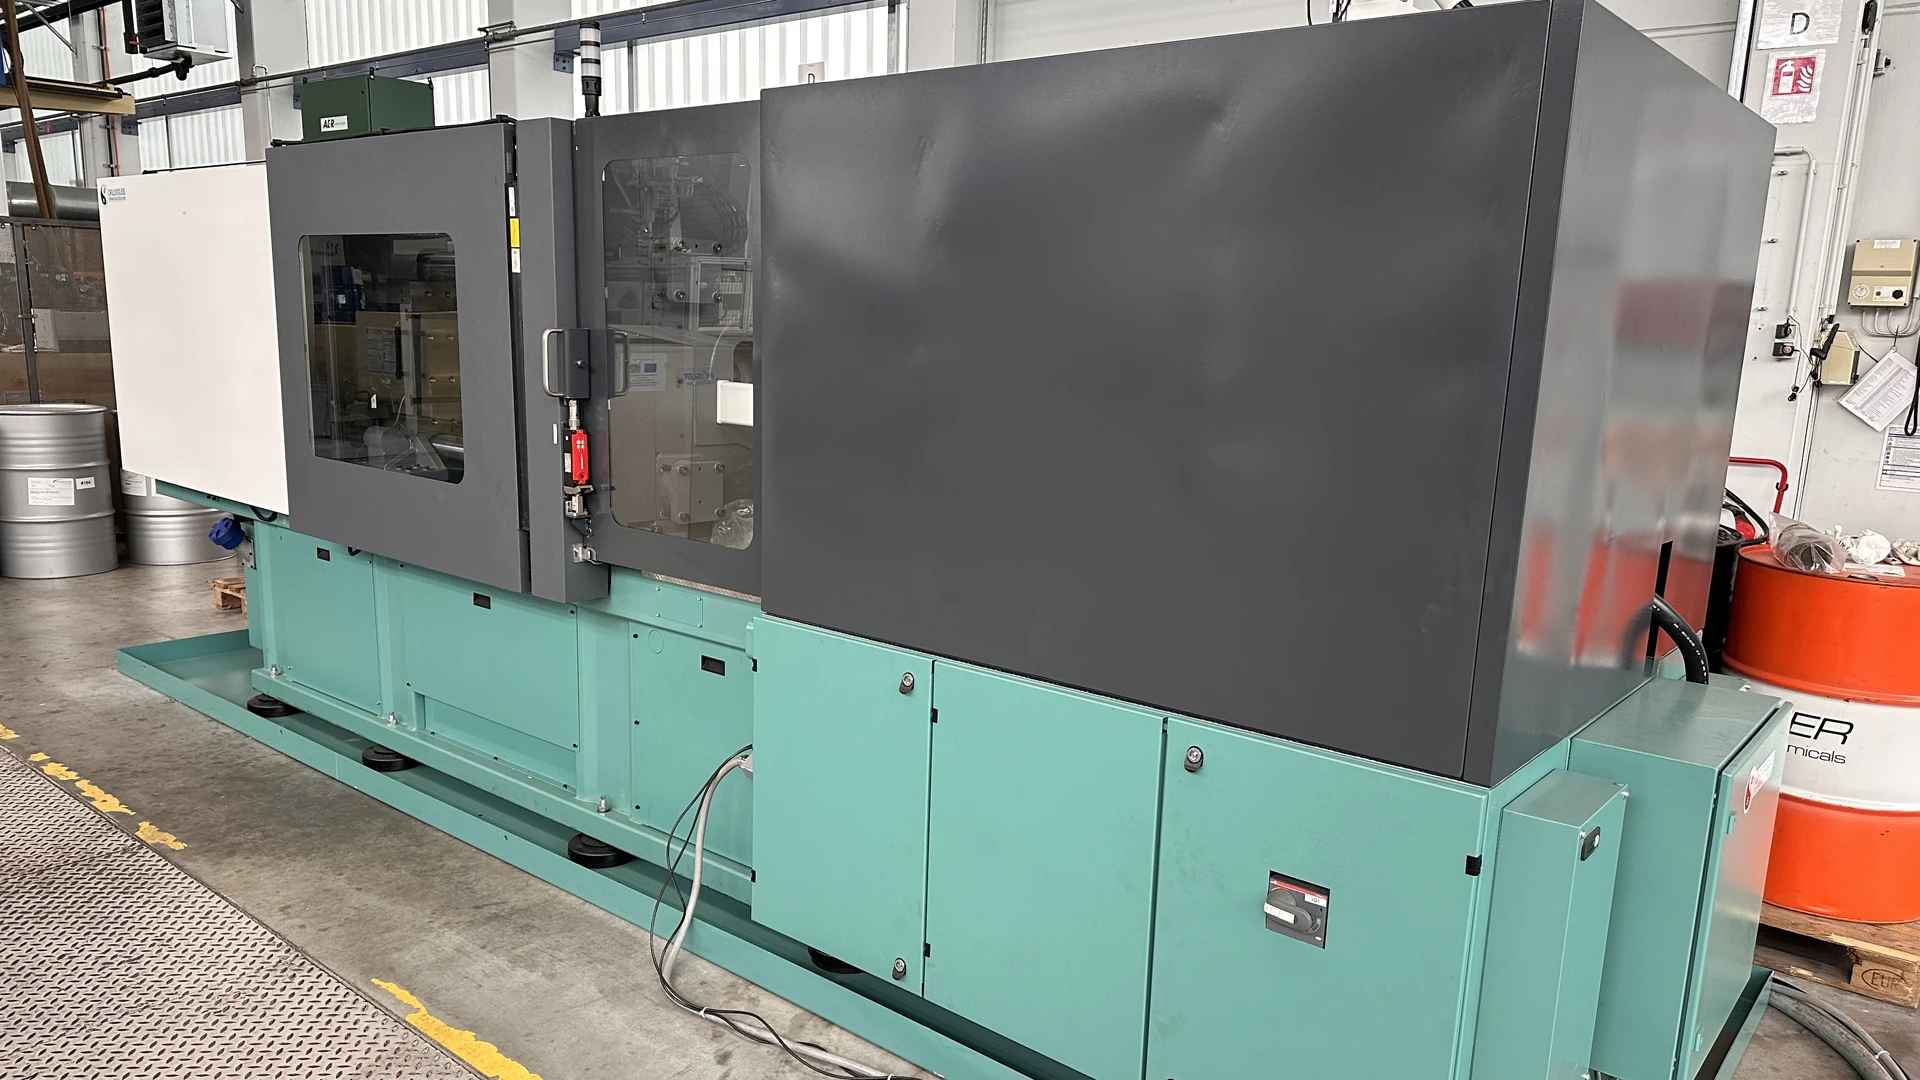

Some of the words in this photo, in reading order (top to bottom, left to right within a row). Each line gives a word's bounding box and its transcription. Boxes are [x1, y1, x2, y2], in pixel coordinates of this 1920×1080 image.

[1789, 12, 1811, 35] D
[323, 119, 334, 129] AER
[1787, 744, 1846, 764] micals
[1871, 972, 1901, 990] EUR
